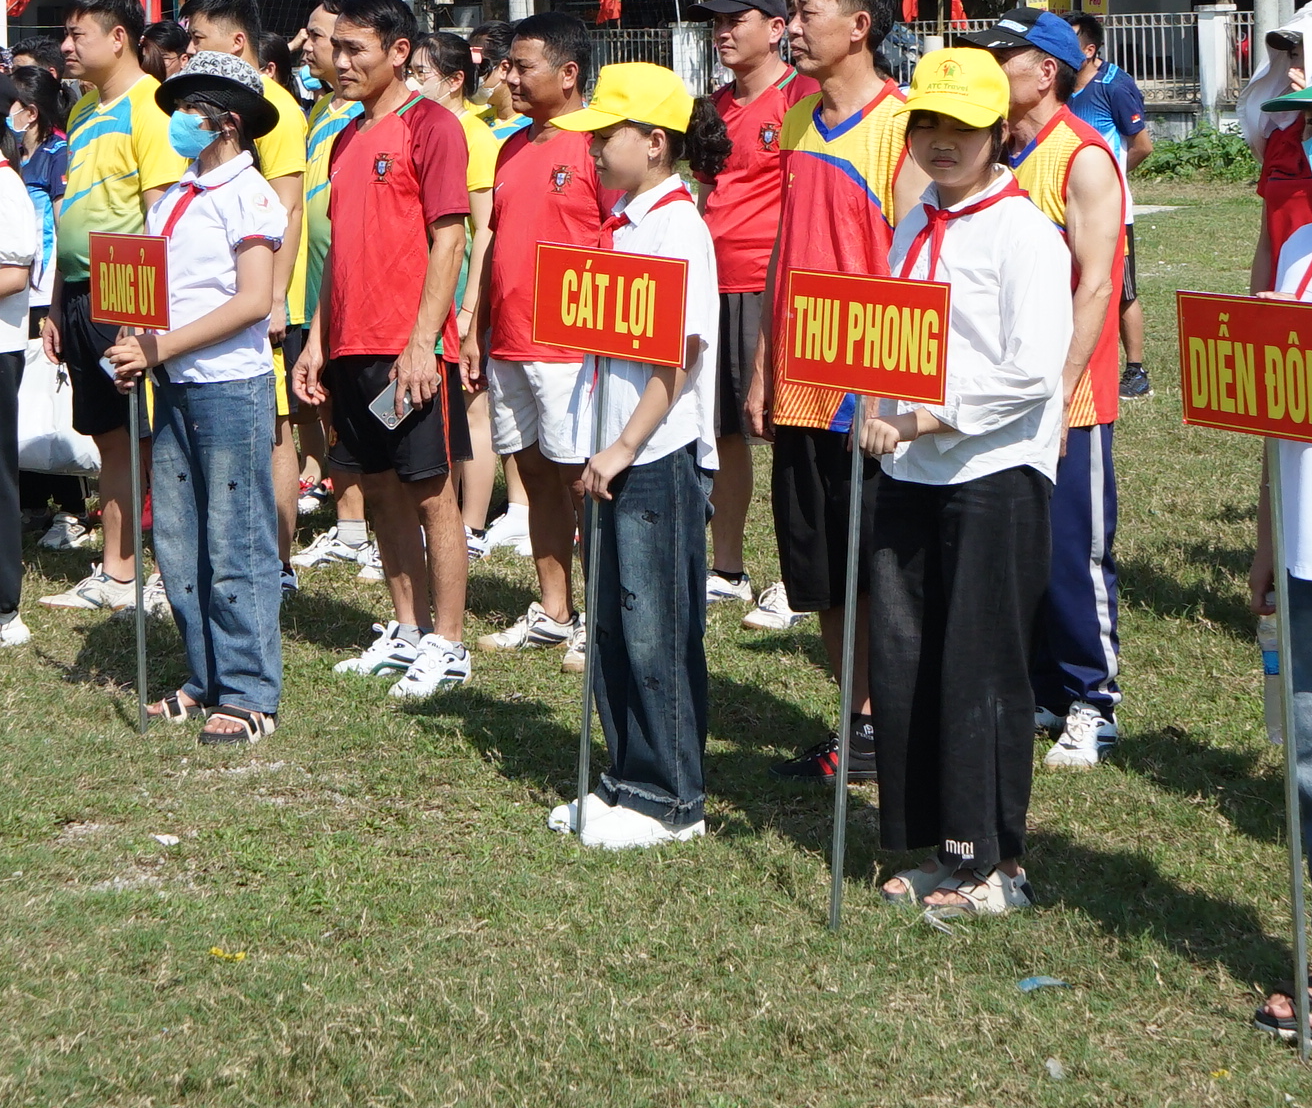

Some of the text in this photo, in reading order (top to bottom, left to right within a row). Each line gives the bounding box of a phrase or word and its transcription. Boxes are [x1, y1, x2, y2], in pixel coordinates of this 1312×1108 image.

[99, 245, 156, 316] ĐẢNG ỦY
[561, 259, 656, 349] CÁT LỢI
[794, 295, 939, 376] THU PHONG
[1189, 312, 1258, 416] DIỄN
